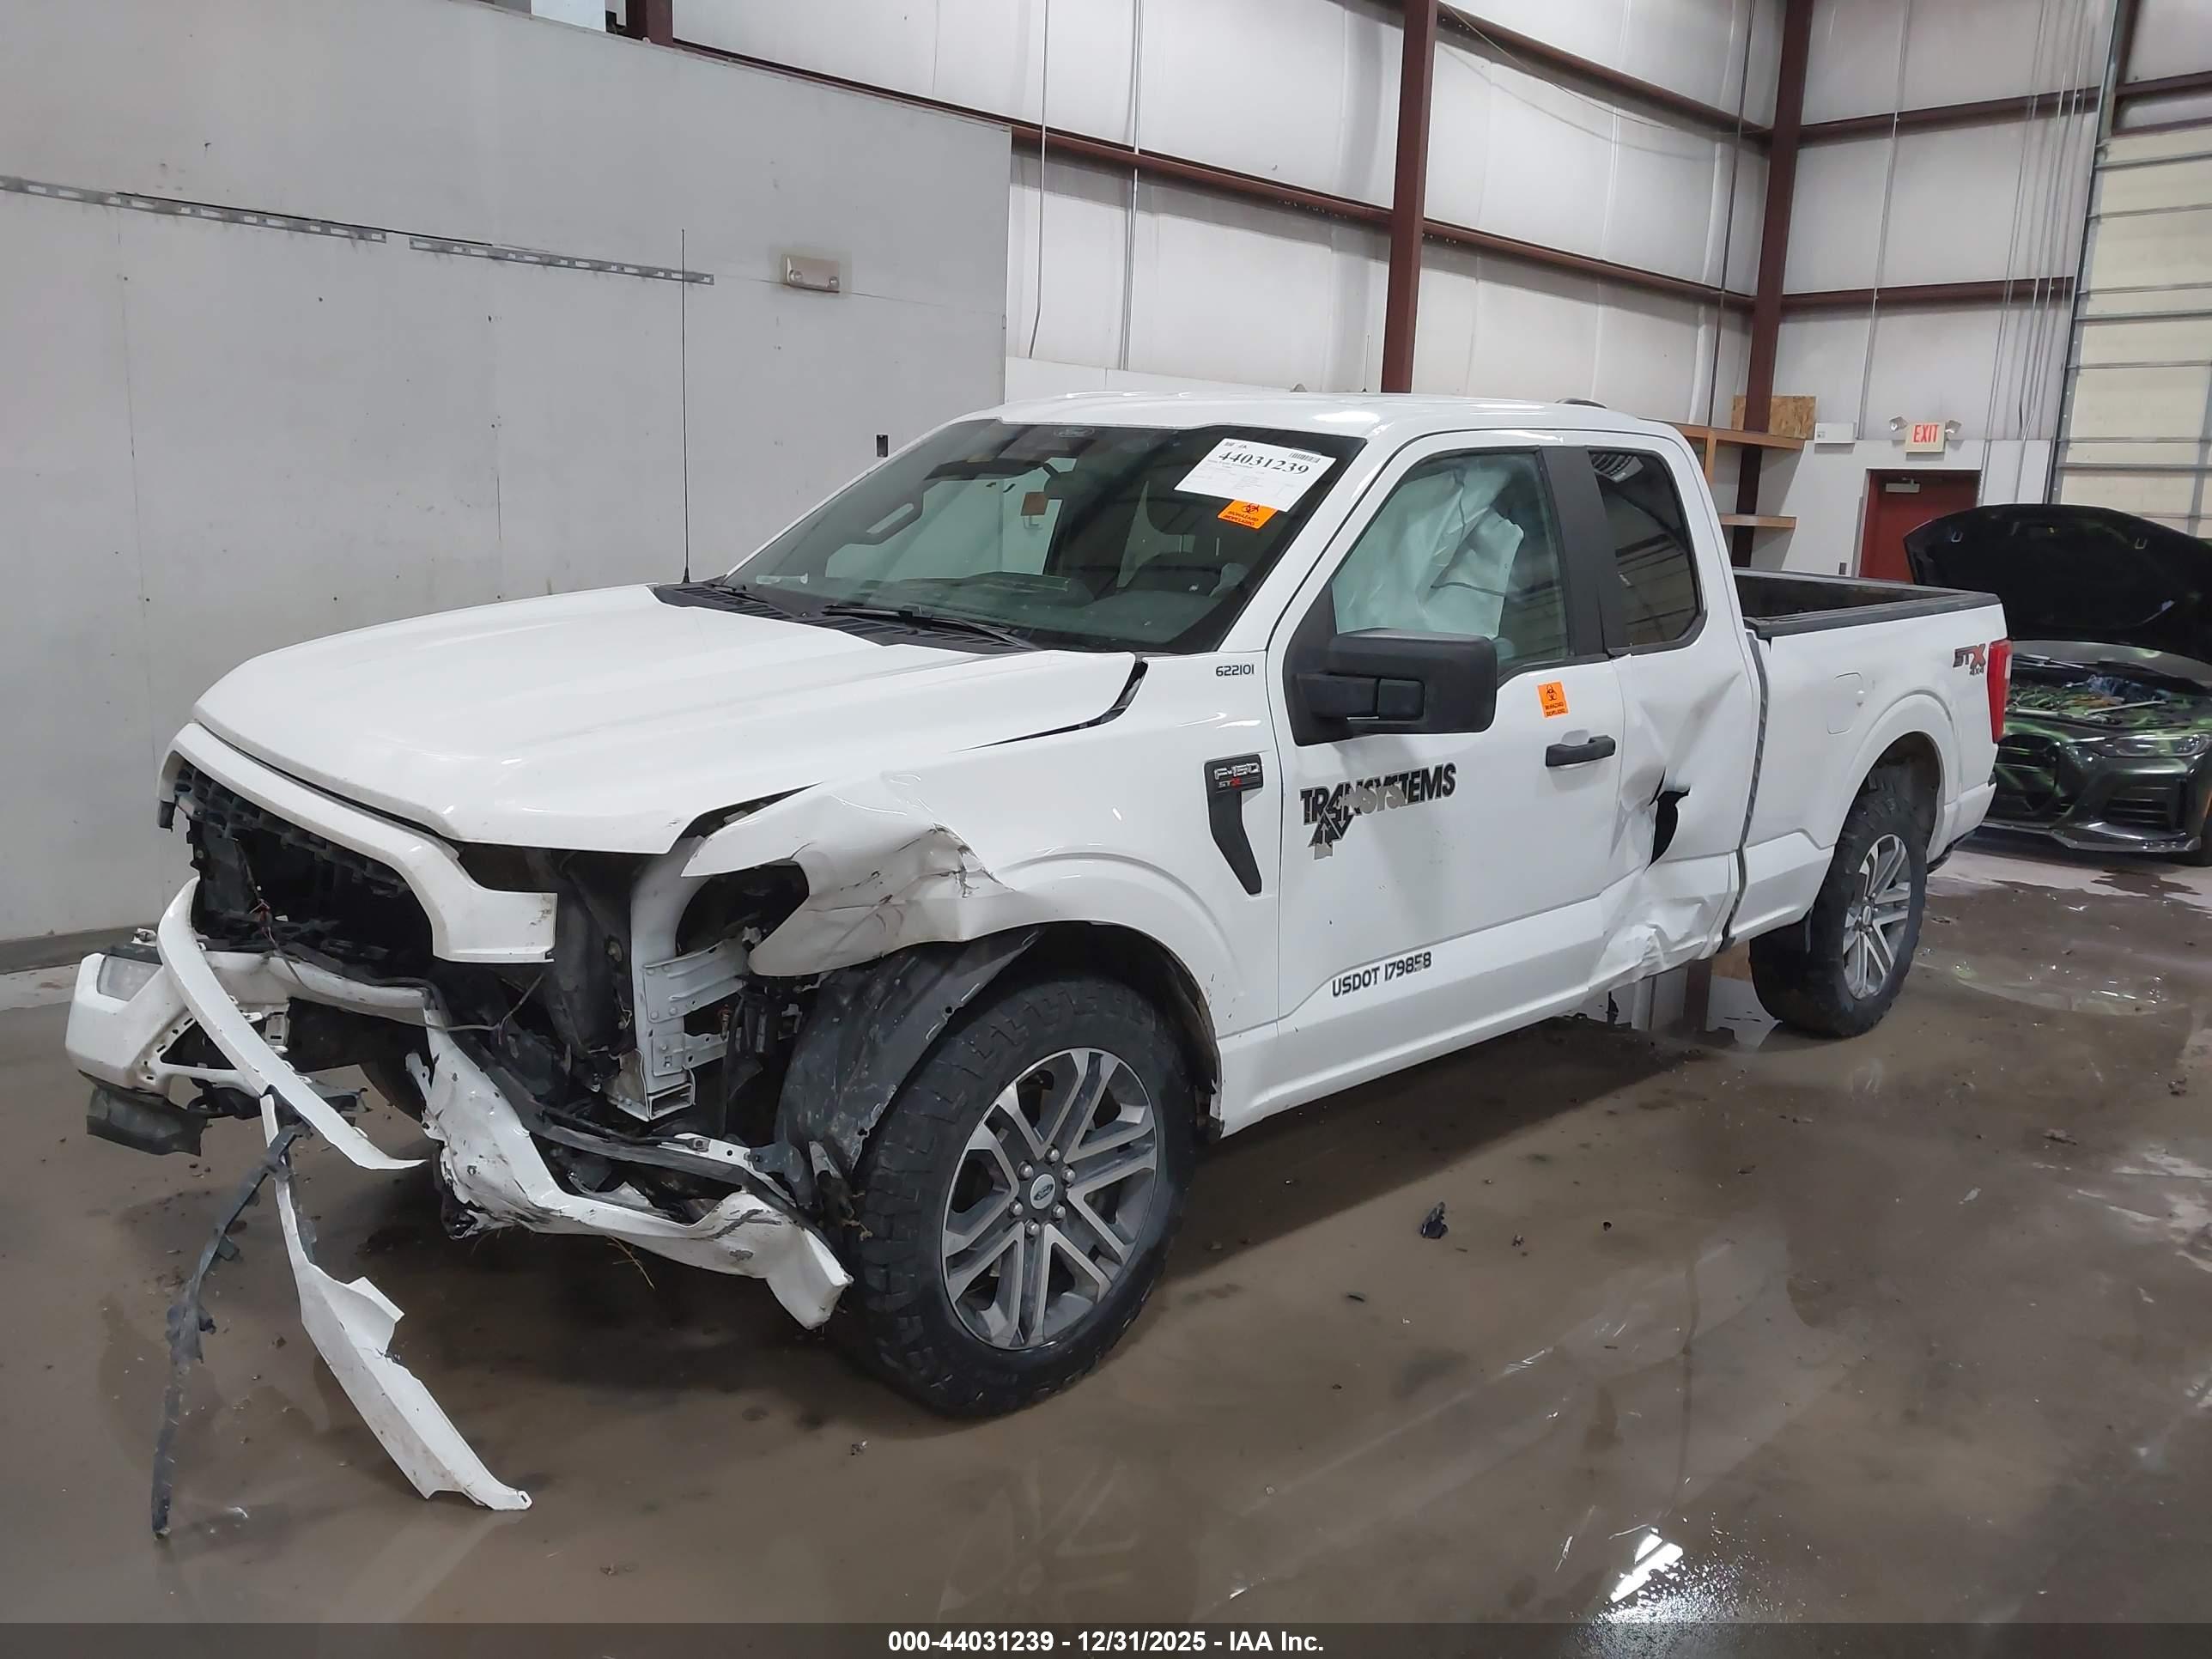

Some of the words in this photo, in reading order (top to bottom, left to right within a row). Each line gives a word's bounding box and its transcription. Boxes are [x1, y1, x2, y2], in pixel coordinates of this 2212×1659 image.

[1913, 424, 1938, 443] EXIT
[1218, 451, 1310, 475] 44031239
[1953, 643, 1986, 668] STX
[1216, 665, 1255, 677] 622101
[1213, 763, 1261, 780] F-150
[1218, 777, 1243, 789] STX
[1332, 966, 1380, 998] USDOT
